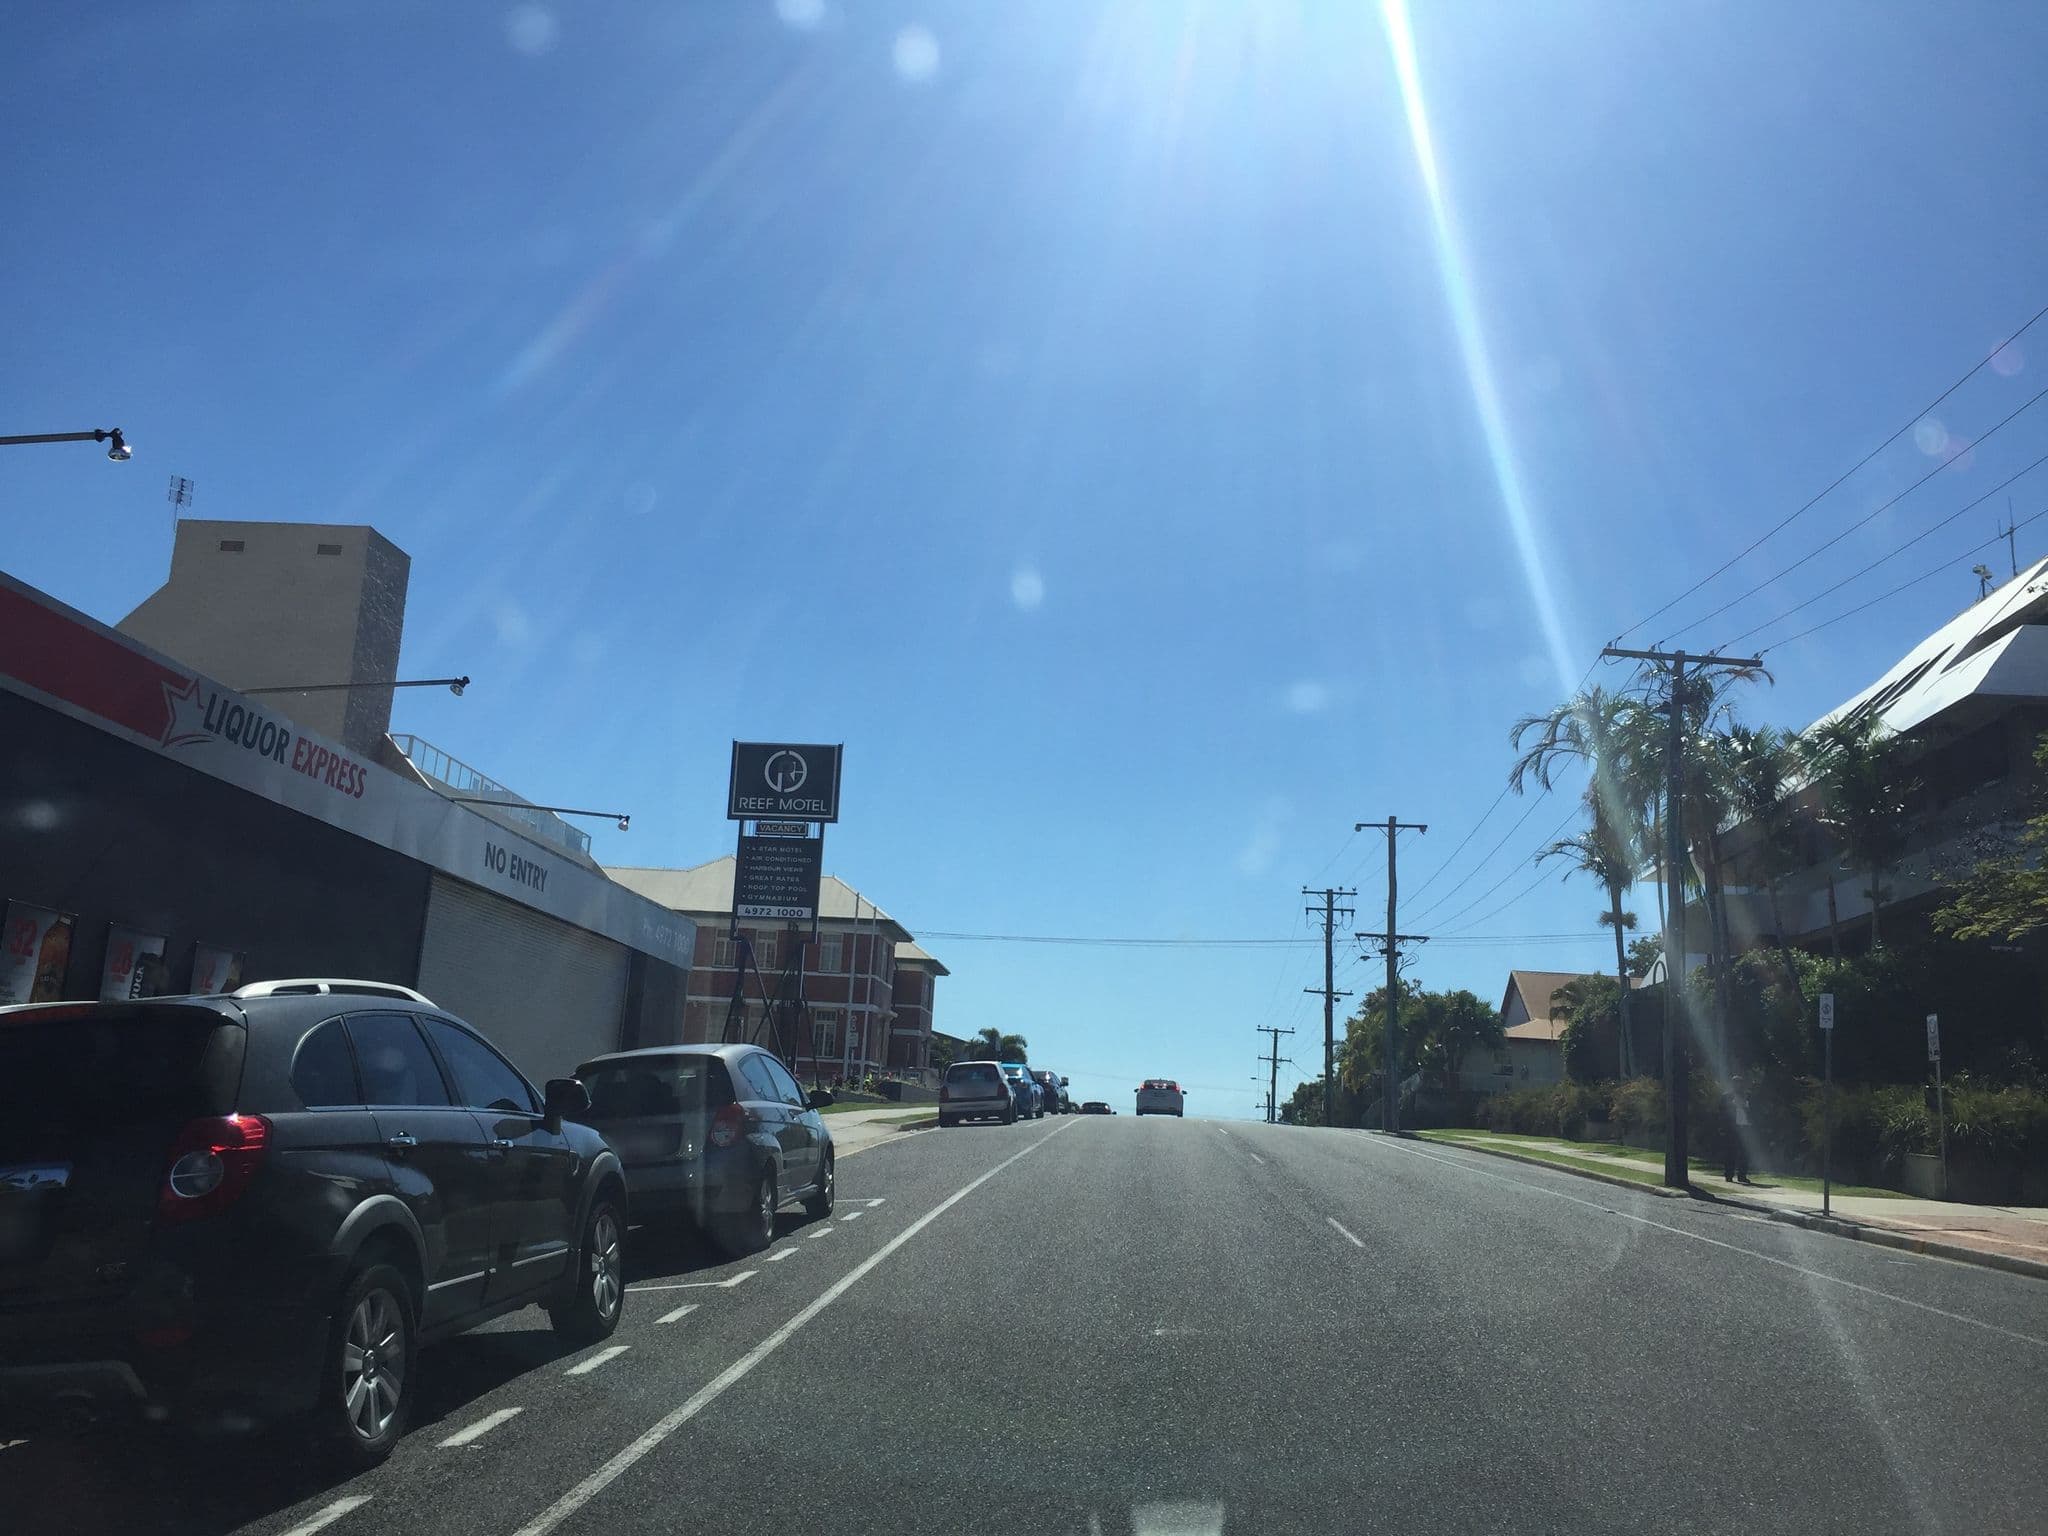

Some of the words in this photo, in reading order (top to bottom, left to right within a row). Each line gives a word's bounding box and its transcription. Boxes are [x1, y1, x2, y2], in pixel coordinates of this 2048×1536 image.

[203, 693, 290, 764] LIQUOR
[291, 736, 367, 800] EXPRESS
[738, 797, 774, 810] REEF
[778, 798, 828, 812] MOTEL
[759, 824, 803, 833] VACANCY
[764, 856, 812, 864] CONDITIONED
[484, 841, 507, 874] NO
[509, 853, 549, 893] ENTRY
[750, 865, 781, 873] HARBOUR
[783, 866, 804, 874] VIEWS
[749, 874, 774, 882] GREAT
[748, 883, 770, 891] ROOF
[746, 893, 799, 902] GYMNASIUM
[745, 907, 772, 916] 4972
[777, 908, 804, 918] 1000
